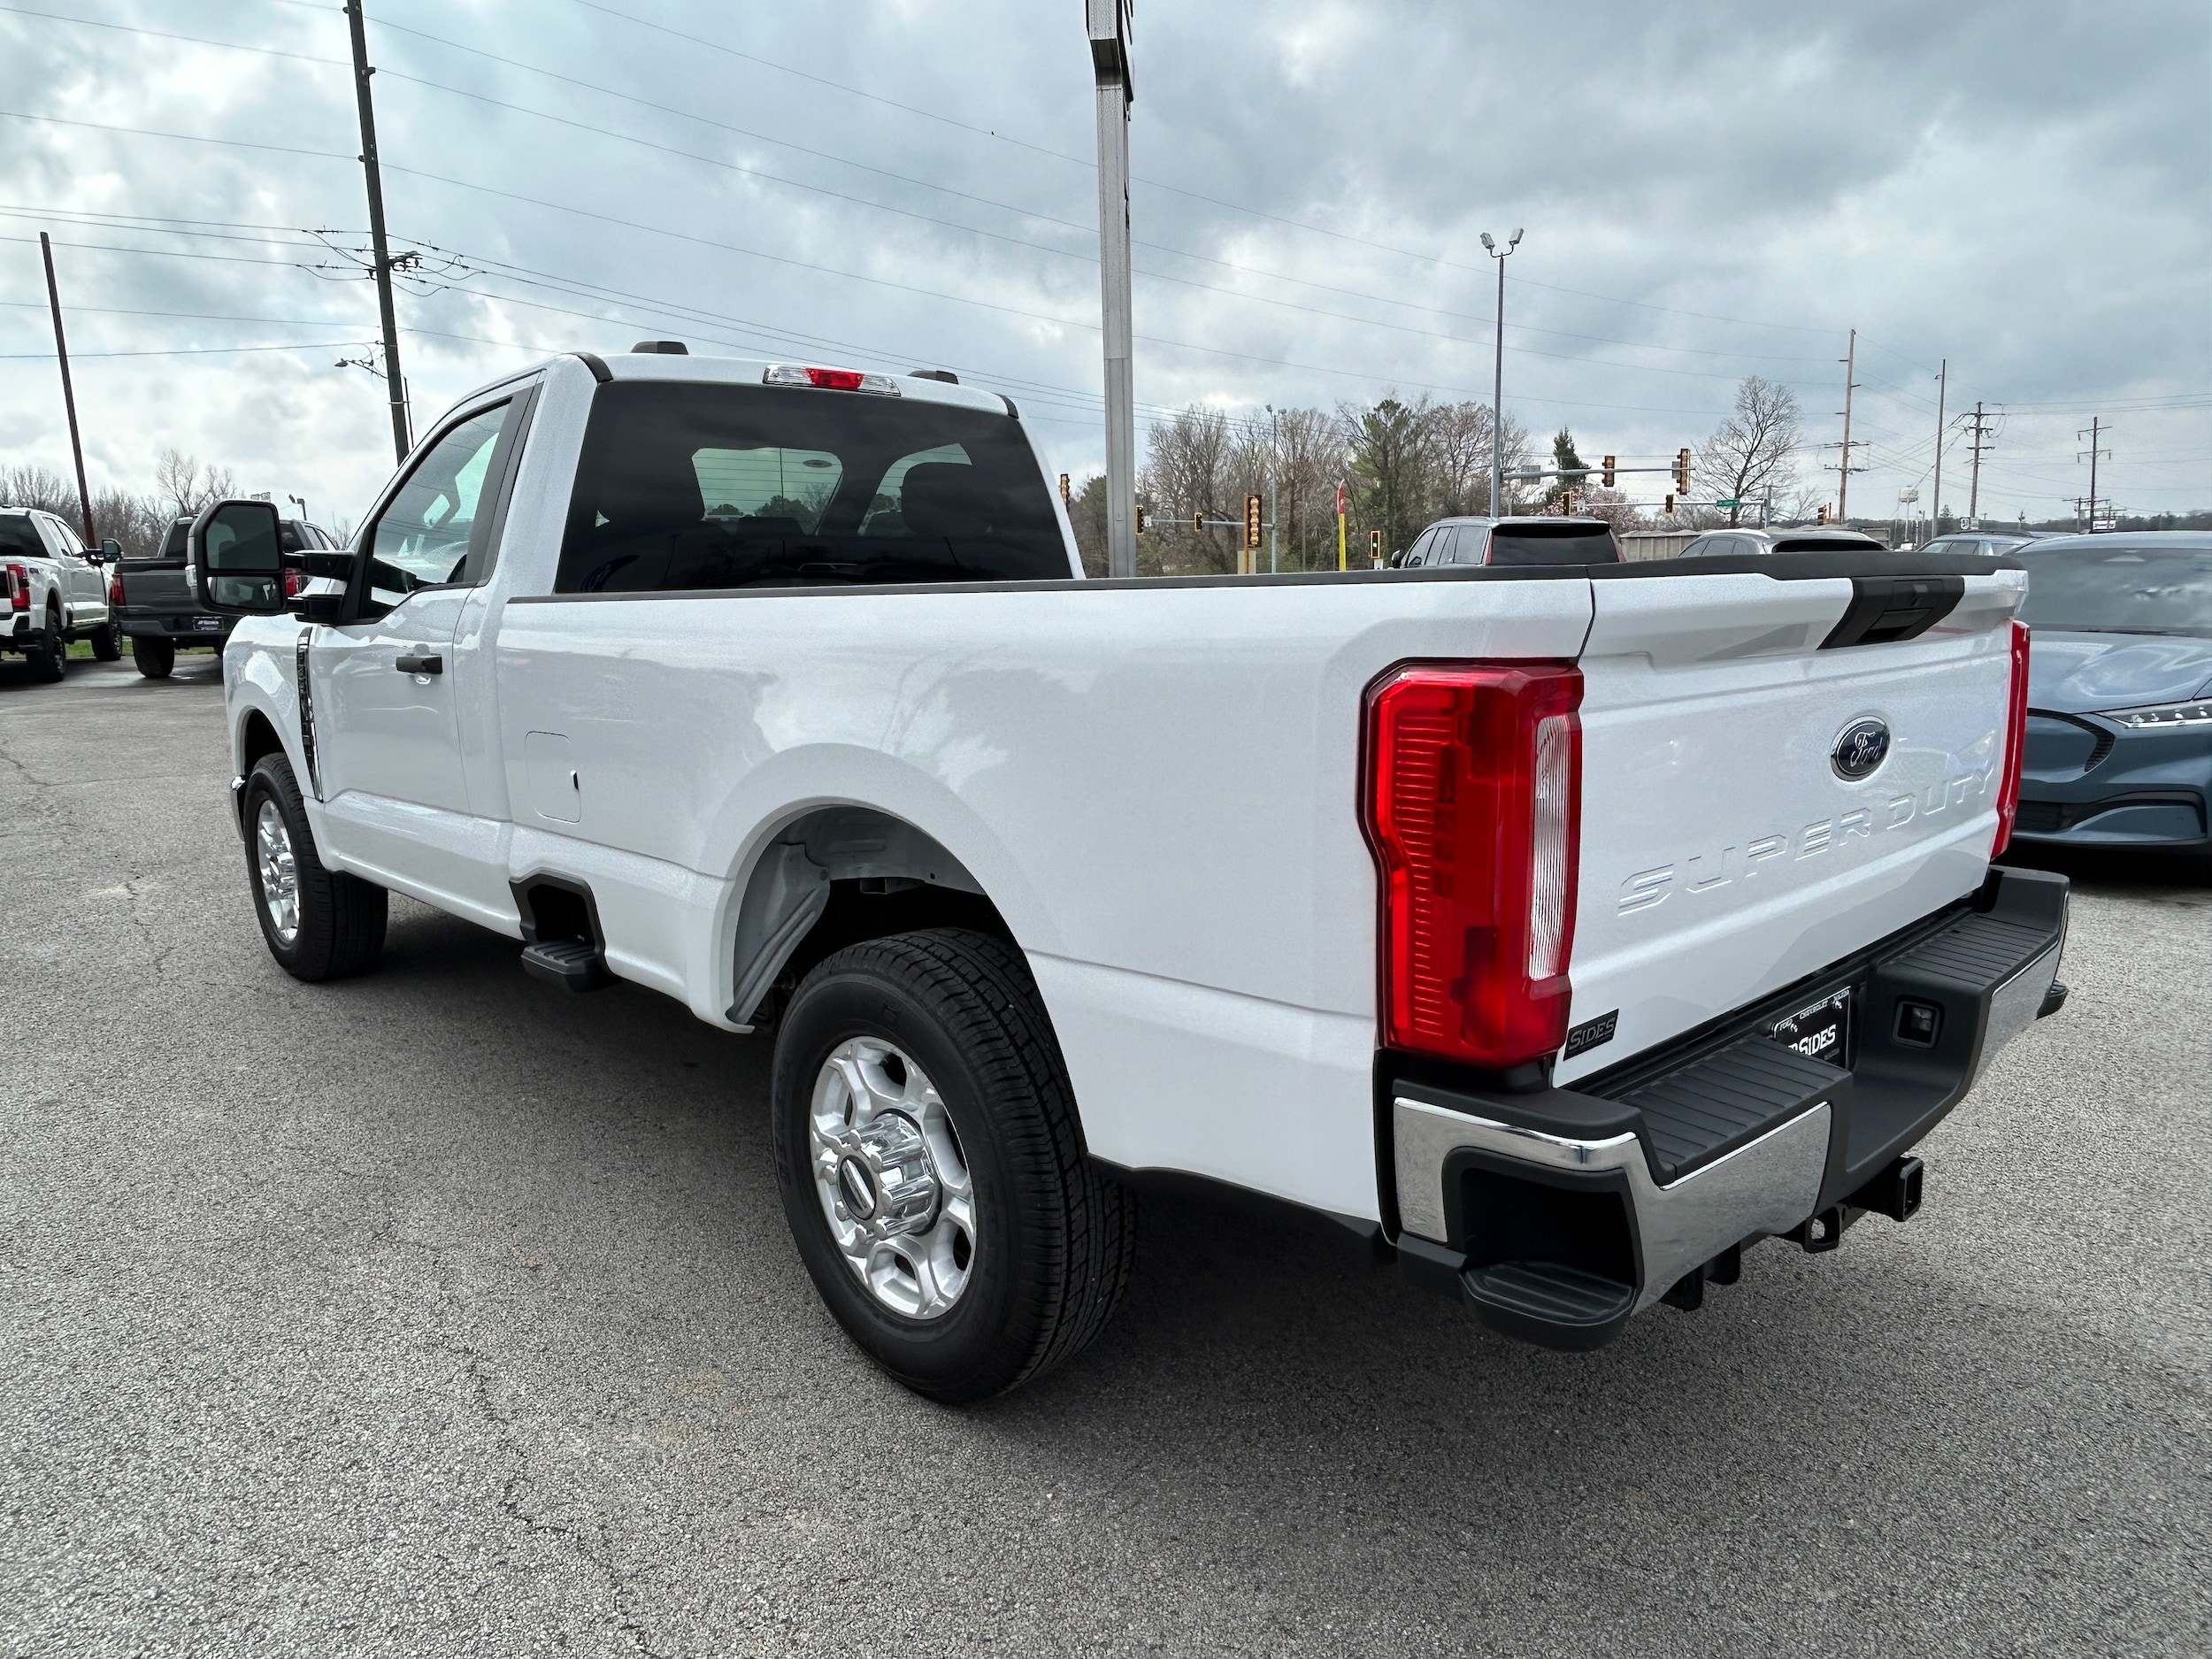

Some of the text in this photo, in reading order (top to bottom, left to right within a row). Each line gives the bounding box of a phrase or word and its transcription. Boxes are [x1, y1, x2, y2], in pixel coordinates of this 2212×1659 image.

[1849, 731, 1884, 768] Ford
[1617, 761, 1994, 918] SUPER DUTY
[1568, 1017, 1617, 1051] SIDES
[1798, 1024, 1837, 1056] SIDES
